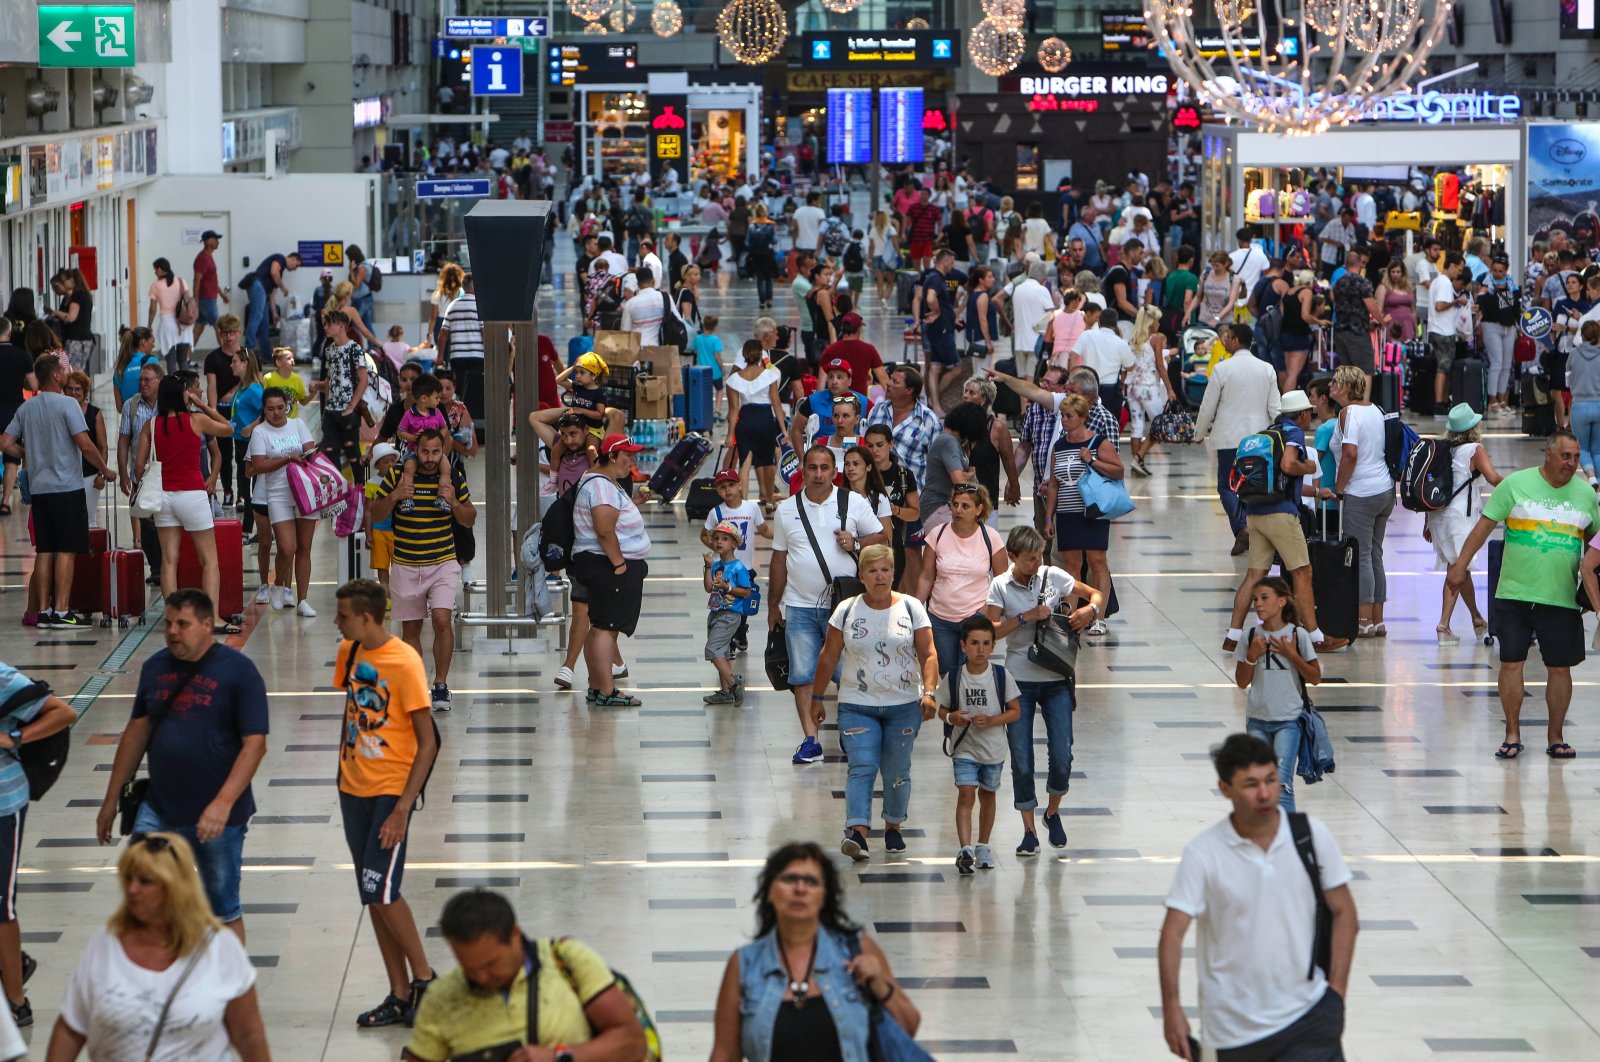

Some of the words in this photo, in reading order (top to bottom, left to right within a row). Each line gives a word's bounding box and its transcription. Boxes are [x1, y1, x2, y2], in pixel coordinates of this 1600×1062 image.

[792, 73, 841, 88] CAFE
[847, 73, 894, 88] SERA
[1020, 76, 1107, 95] BURGER
[1111, 75, 1167, 93] KING
[1526, 317, 1550, 334] Relax
[1405, 440, 1426, 497] HEAD
[965, 688, 987, 698] LIKE
[966, 697, 988, 706] EVER
